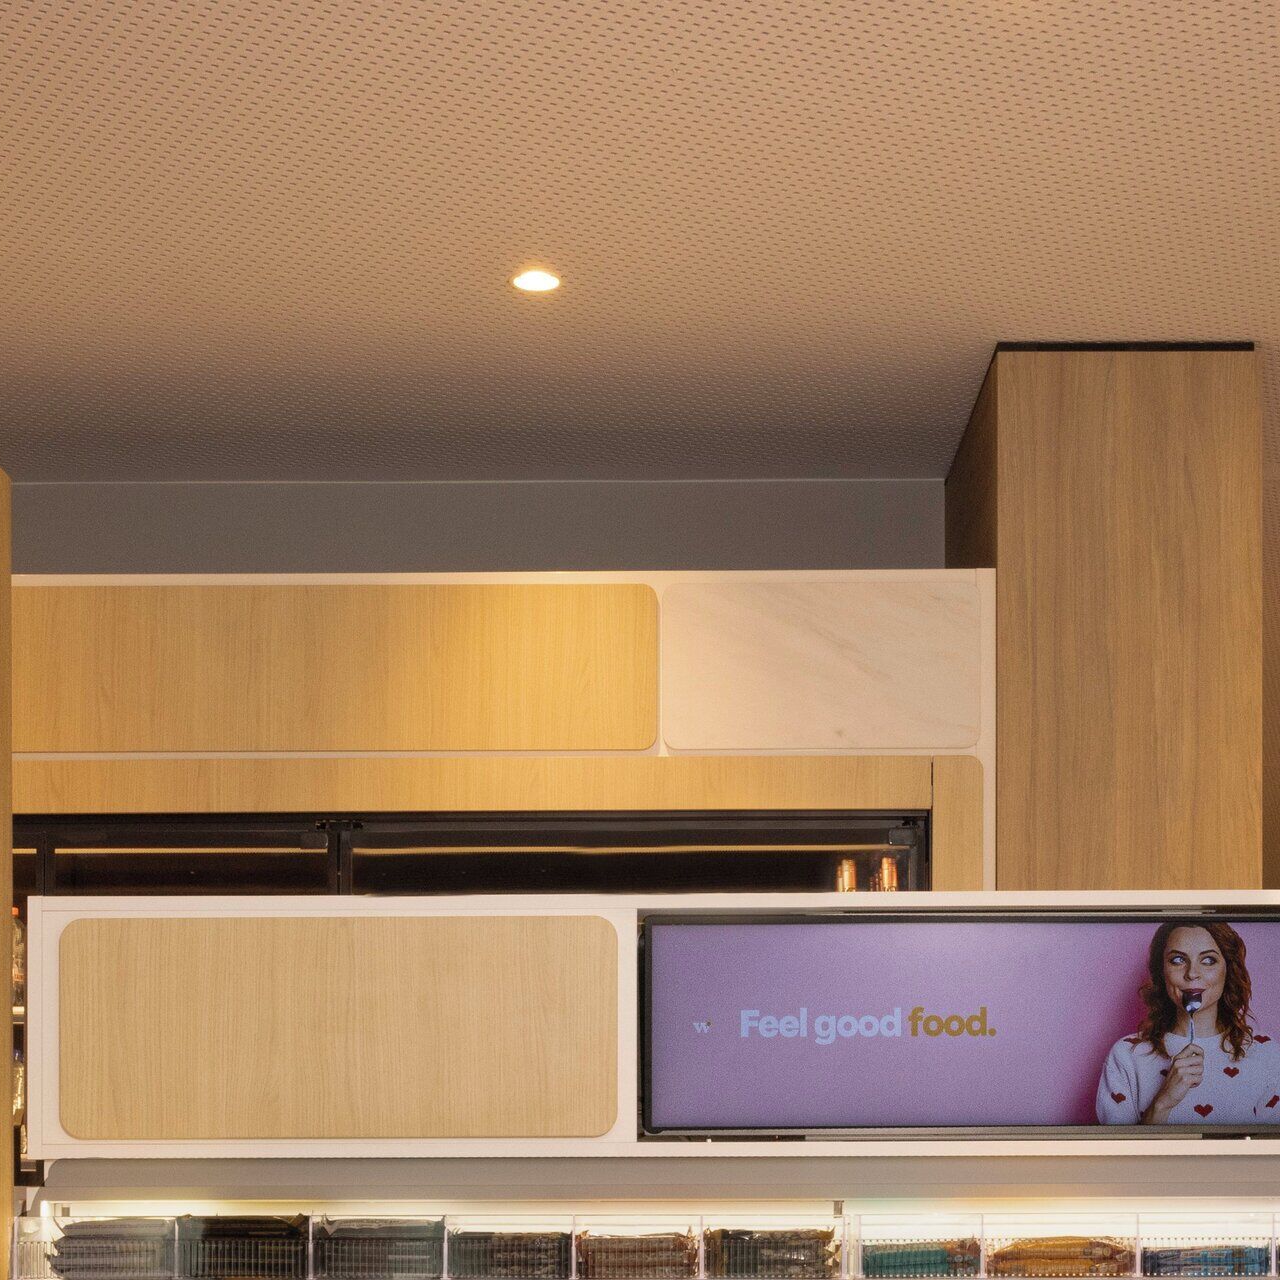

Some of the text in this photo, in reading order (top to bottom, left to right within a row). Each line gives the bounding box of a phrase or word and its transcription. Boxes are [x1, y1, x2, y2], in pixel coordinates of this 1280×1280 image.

[740, 1006, 997, 1046] Feel good food.
